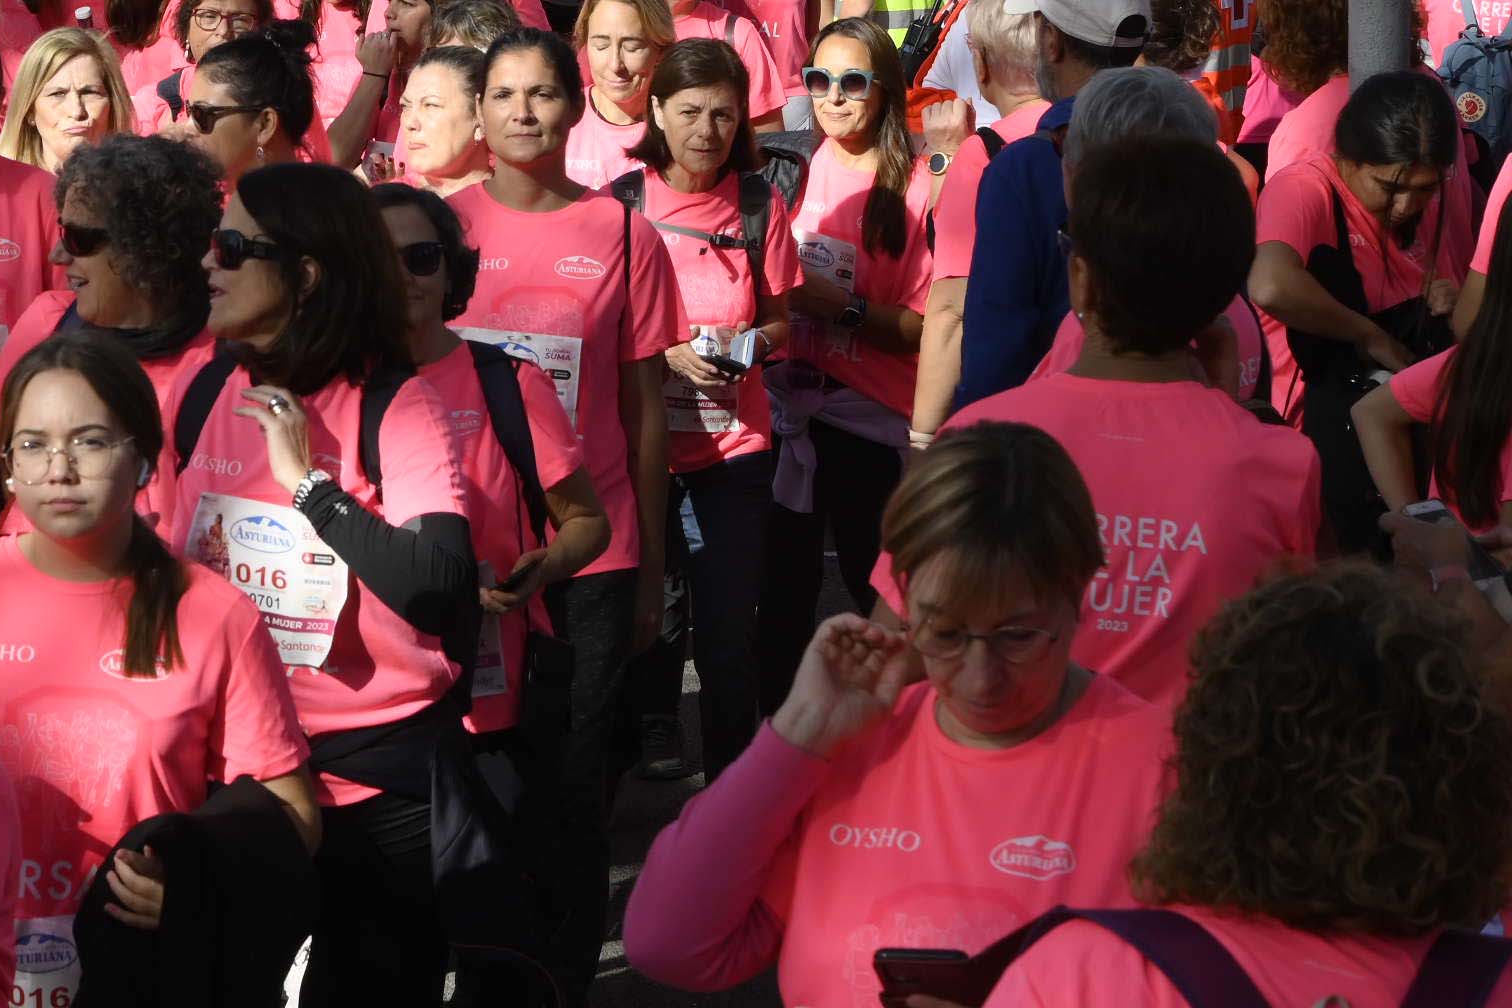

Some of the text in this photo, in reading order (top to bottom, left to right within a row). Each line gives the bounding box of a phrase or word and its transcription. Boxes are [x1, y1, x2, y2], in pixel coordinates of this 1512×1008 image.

[558, 263, 603, 275] ASTURIANA
[544, 353, 571, 361] SUMA
[235, 525, 291, 548] ASTURIANA
[1096, 513, 1208, 555] RRERA
[236, 563, 287, 589] 016
[1126, 551, 1171, 584] LA
[249, 592, 281, 610] 0701
[1089, 582, 1173, 618] UJER
[272, 617, 303, 630] MUJER
[306, 621, 329, 631] 2023
[1097, 618, 1129, 633] 2023
[828, 823, 922, 853] OYSHO
[995, 849, 1070, 871] ASTURIANA
[10, 986, 71, 1008] 016
